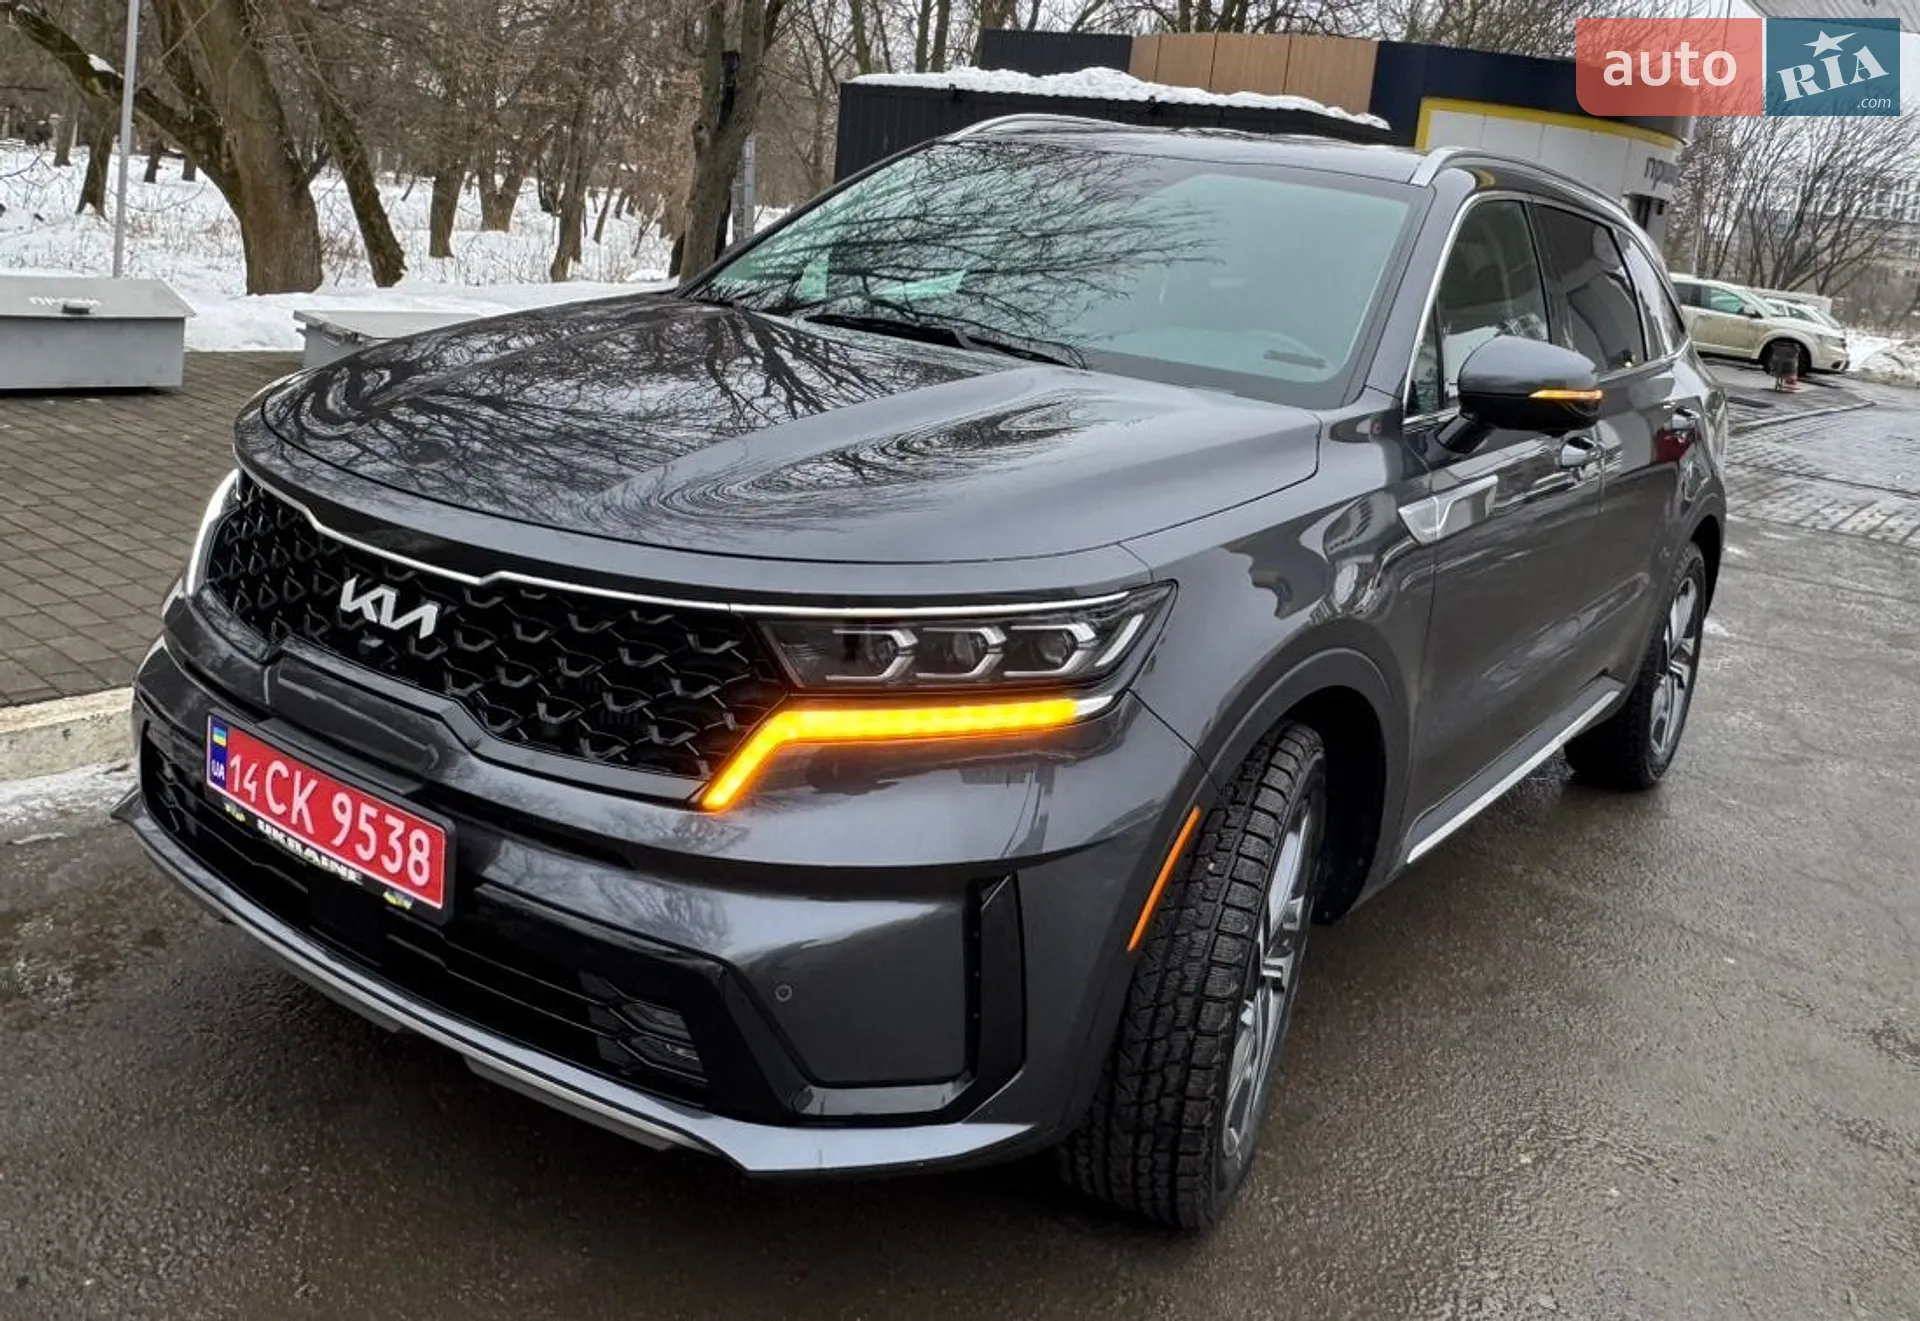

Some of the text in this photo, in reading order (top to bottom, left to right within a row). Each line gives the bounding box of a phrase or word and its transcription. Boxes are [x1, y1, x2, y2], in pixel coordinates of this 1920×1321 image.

[340, 572, 439, 639] KIA
[211, 759, 225, 781] UA
[331, 792, 430, 886] 9538
